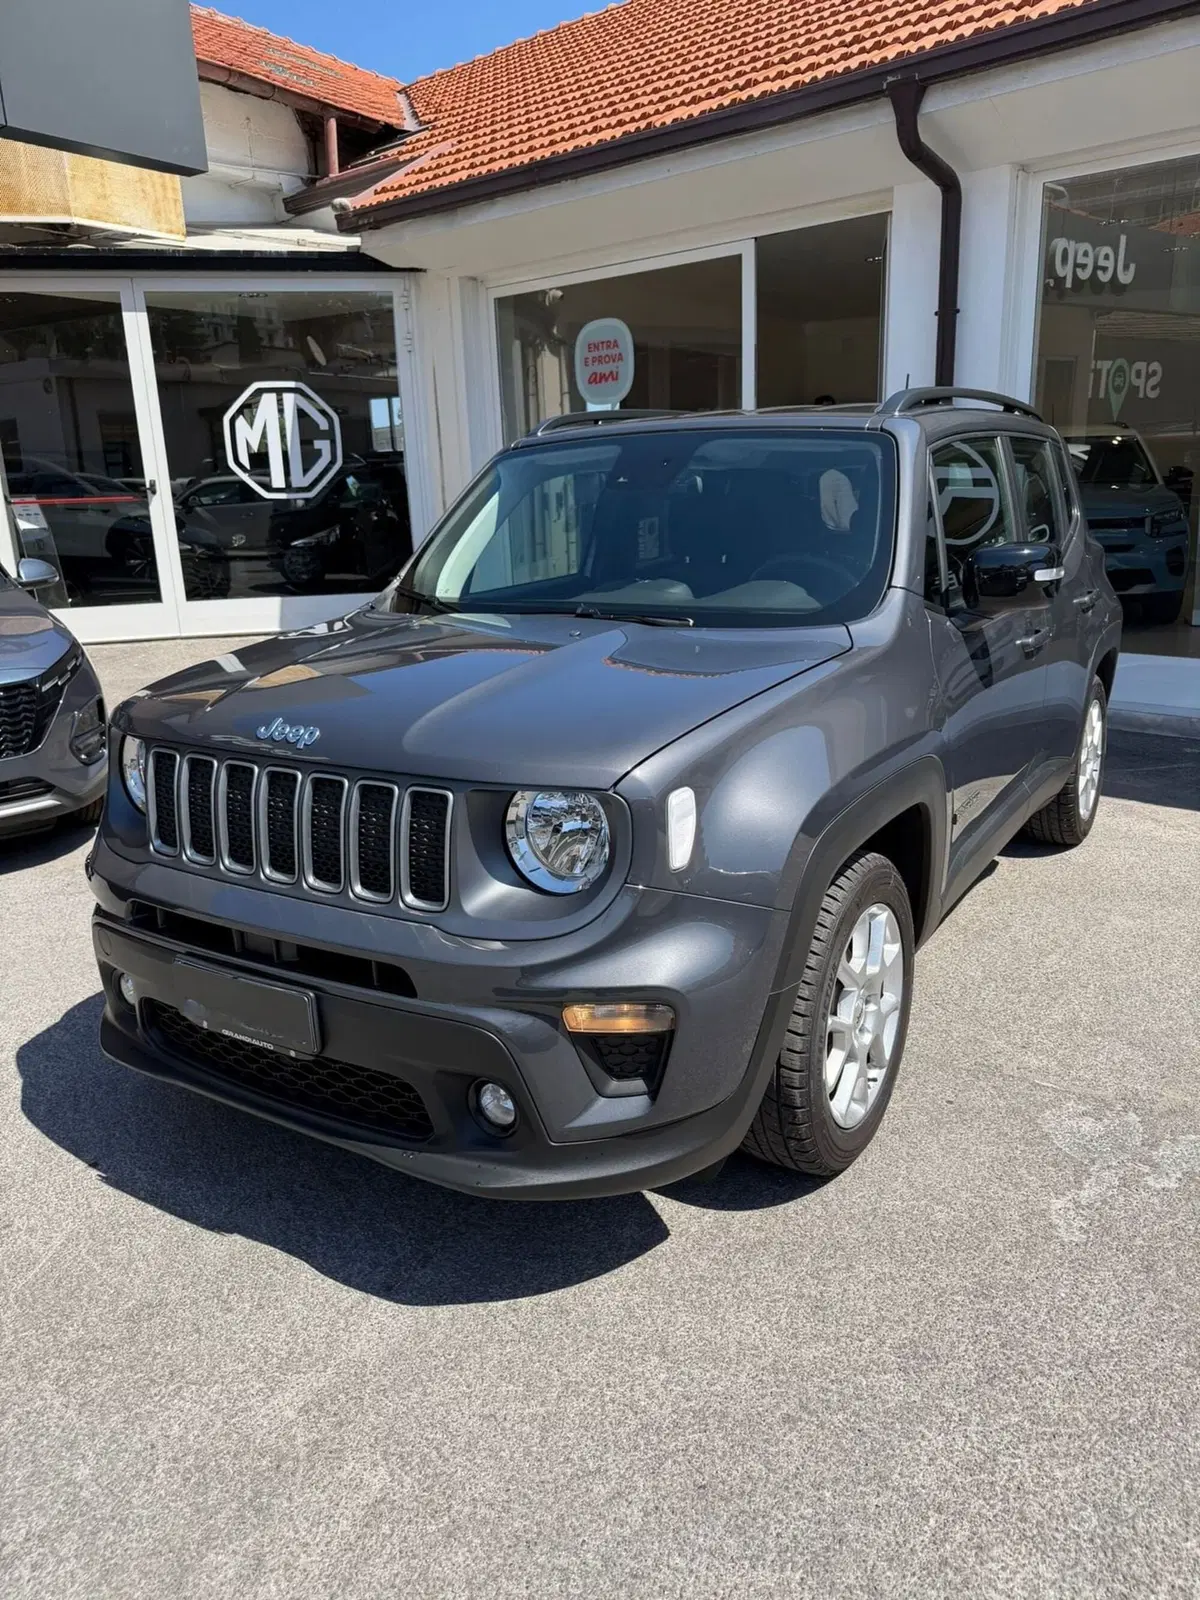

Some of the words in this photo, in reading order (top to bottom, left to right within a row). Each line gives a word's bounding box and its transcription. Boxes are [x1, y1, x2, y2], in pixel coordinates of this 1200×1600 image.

[587, 339, 619, 353] ENTRA
[584, 357, 590, 367] E
[591, 352, 624, 366] PROVA
[587, 366, 619, 385] ami
[235, 392, 332, 488] MG
[256, 717, 320, 749] Jeep
[221, 1029, 274, 1050] GRANDIAUTO
